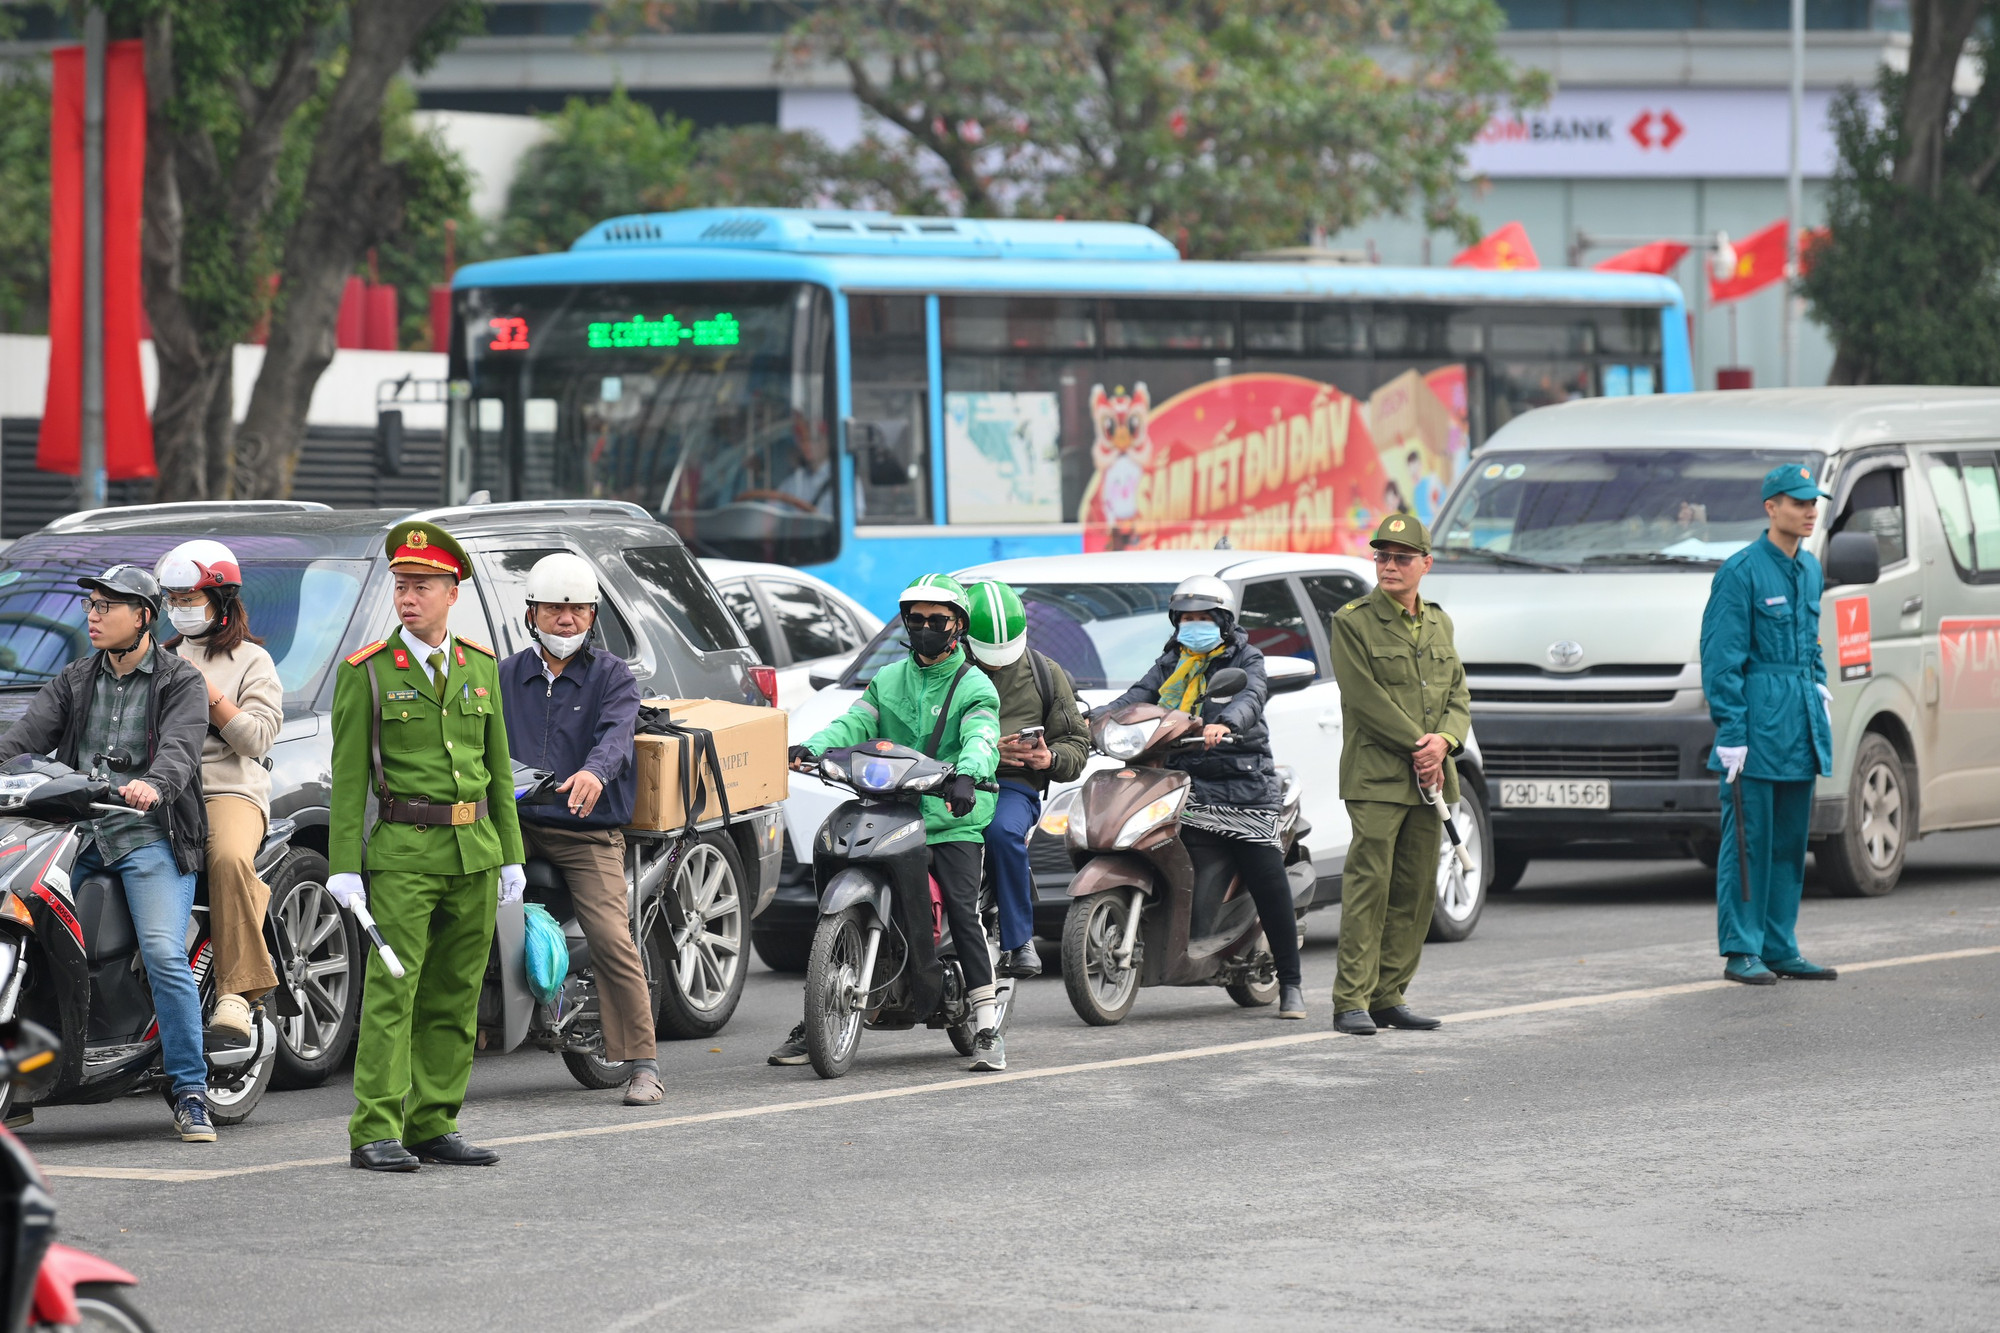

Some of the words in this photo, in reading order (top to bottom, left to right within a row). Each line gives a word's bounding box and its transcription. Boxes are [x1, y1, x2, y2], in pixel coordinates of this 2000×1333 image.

[1138, 446, 1194, 521] SẮM
[1196, 420, 1245, 516] TẾT
[1243, 405, 1287, 499] ĐỦ
[1287, 382, 1353, 484] ĐẦY
[1971, 628, 2000, 672] LA
[55, 902, 74, 925] BOSCH
